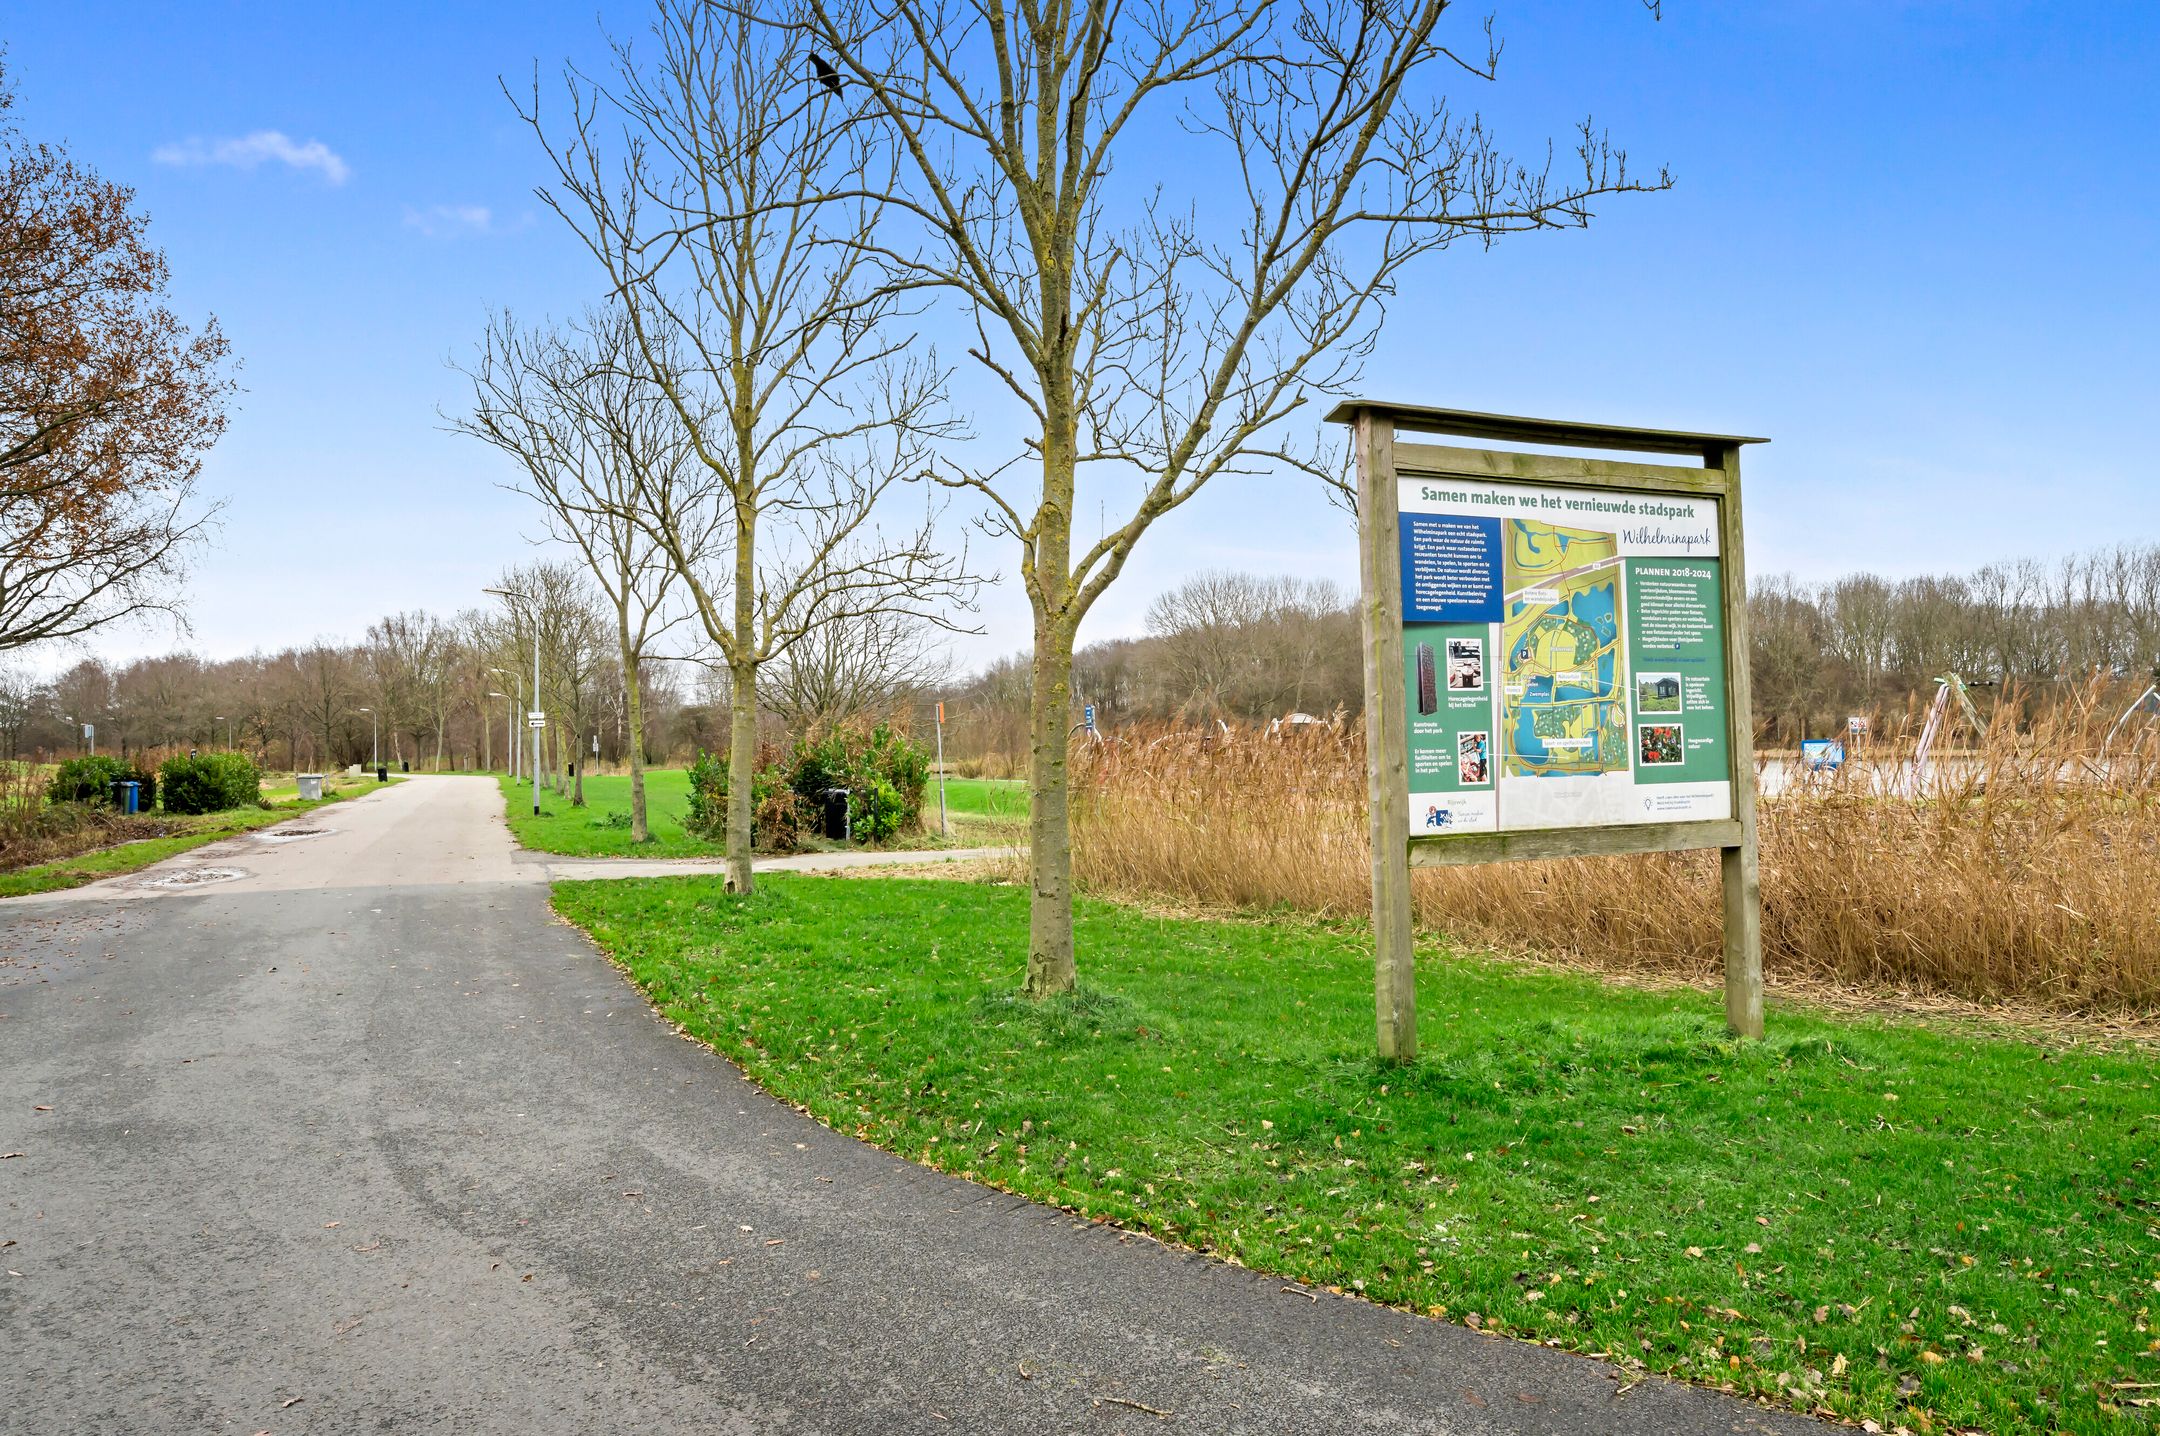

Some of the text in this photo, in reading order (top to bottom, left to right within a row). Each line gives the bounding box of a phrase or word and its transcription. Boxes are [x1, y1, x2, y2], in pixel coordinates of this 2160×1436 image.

[1422, 486, 1694, 520] Samen maken we het vernieuwde stadspark
[1623, 526, 1711, 552] Wilhelminapark
[1636, 568, 1711, 580] PLANNEN 2018-2024
